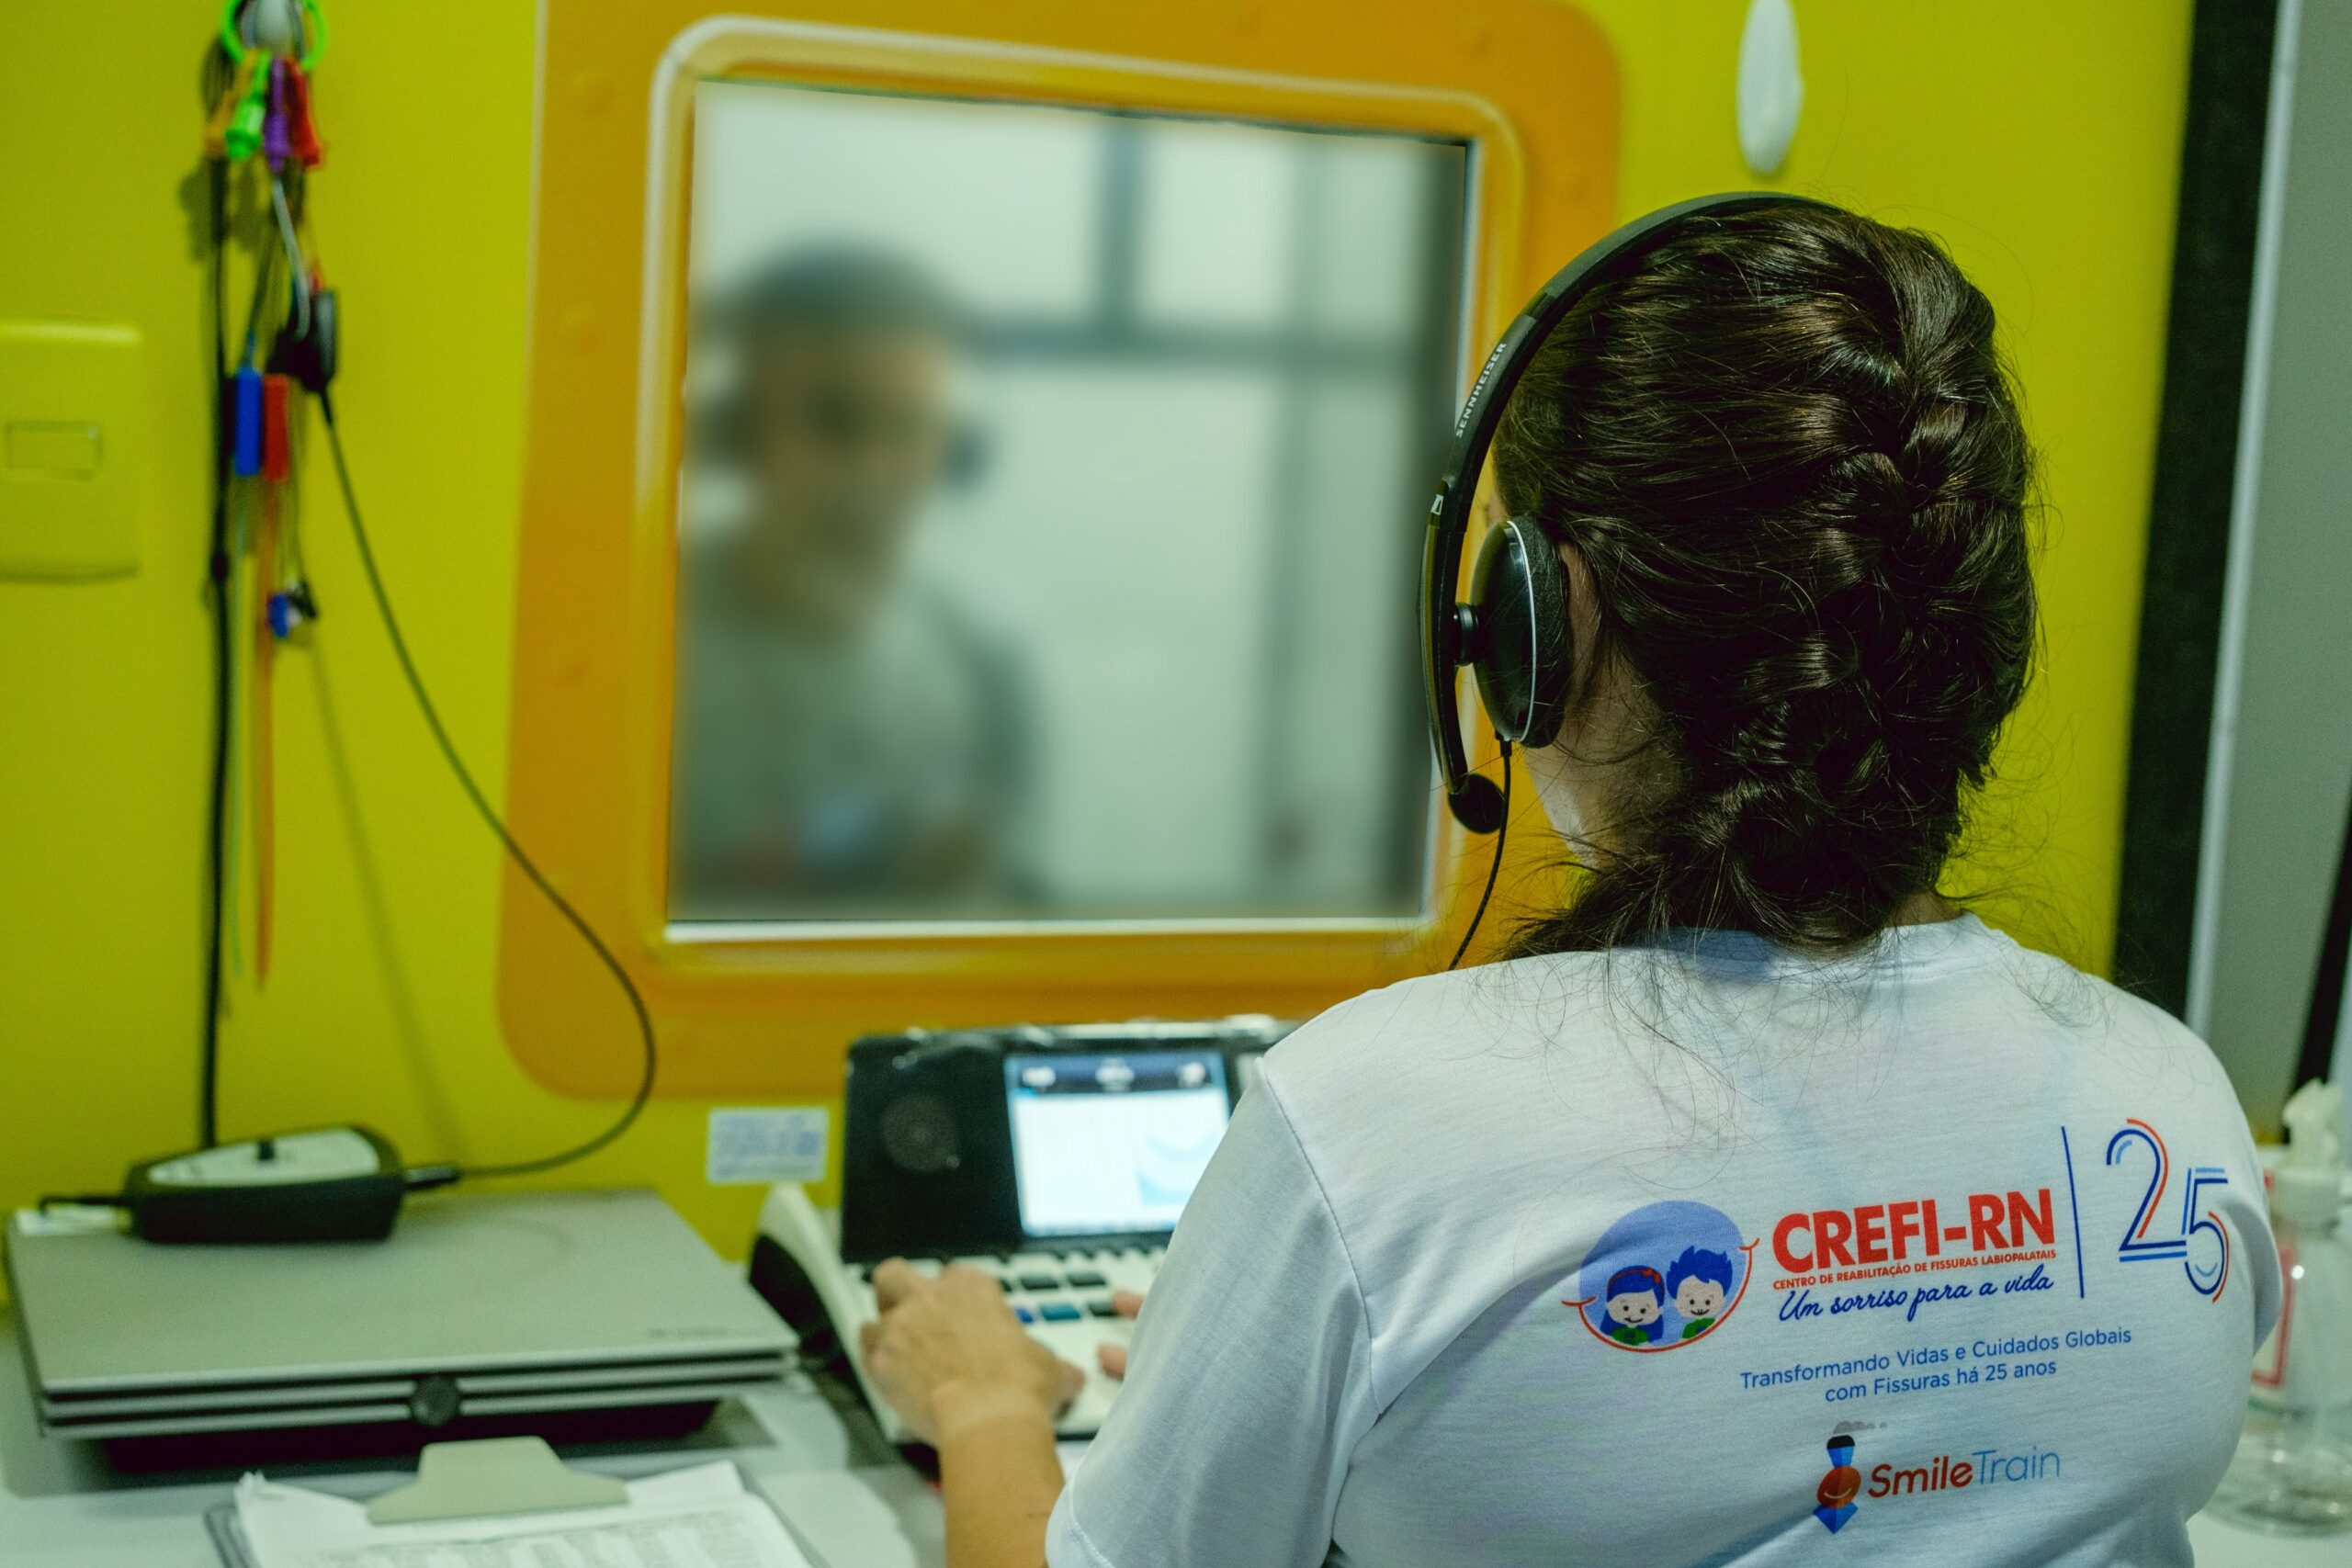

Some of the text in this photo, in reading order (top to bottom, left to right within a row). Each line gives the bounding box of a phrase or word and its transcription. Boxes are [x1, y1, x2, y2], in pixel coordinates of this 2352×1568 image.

[1456, 343, 1507, 438] SENNHEISER
[1772, 1189, 2055, 1273] CREFI-RN
[2106, 1118, 2229, 1303] 25
[1773, 1249, 2056, 1290] CENTRO DE REABILITAÇÃO DE FISSURAS LABIOPALATAIS
[1779, 1264, 2054, 1322] Um sorriso para a vida
[1740, 1326, 2132, 1389] Transformando Vidas e Cuidados Globais
[1826, 1361, 2057, 1402] com Fissuras há 25 anos
